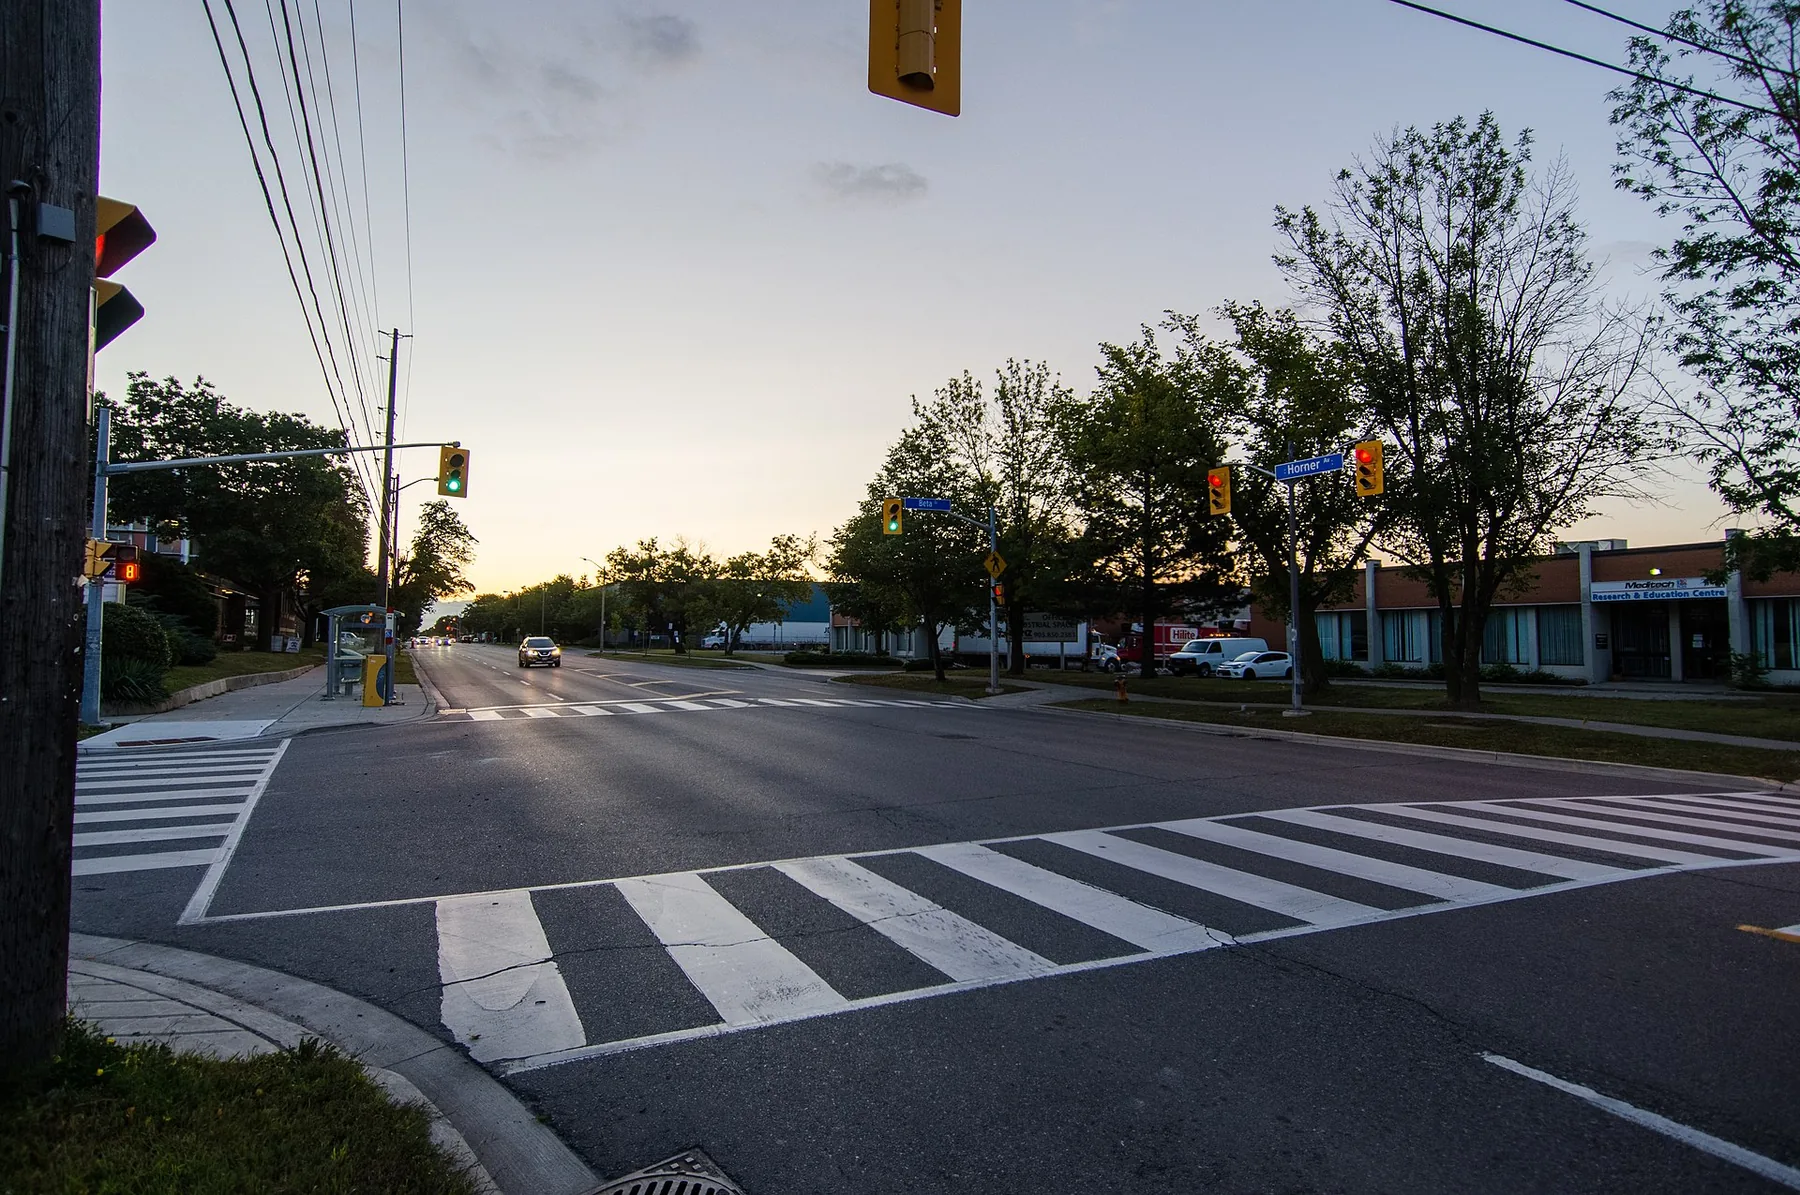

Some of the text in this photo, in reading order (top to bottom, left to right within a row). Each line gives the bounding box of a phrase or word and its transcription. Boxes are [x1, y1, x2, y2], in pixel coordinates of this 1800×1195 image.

[1287, 461, 1320, 475] Horner
[919, 499, 932, 508] Beta
[126, 565, 134, 578] 8
[1625, 581, 1675, 589] Meditech
[1592, 592, 1631, 600] Research
[1643, 590, 1690, 599] Education
[1692, 589, 1725, 597] Centre
[1173, 629, 1195, 639] Hilite
